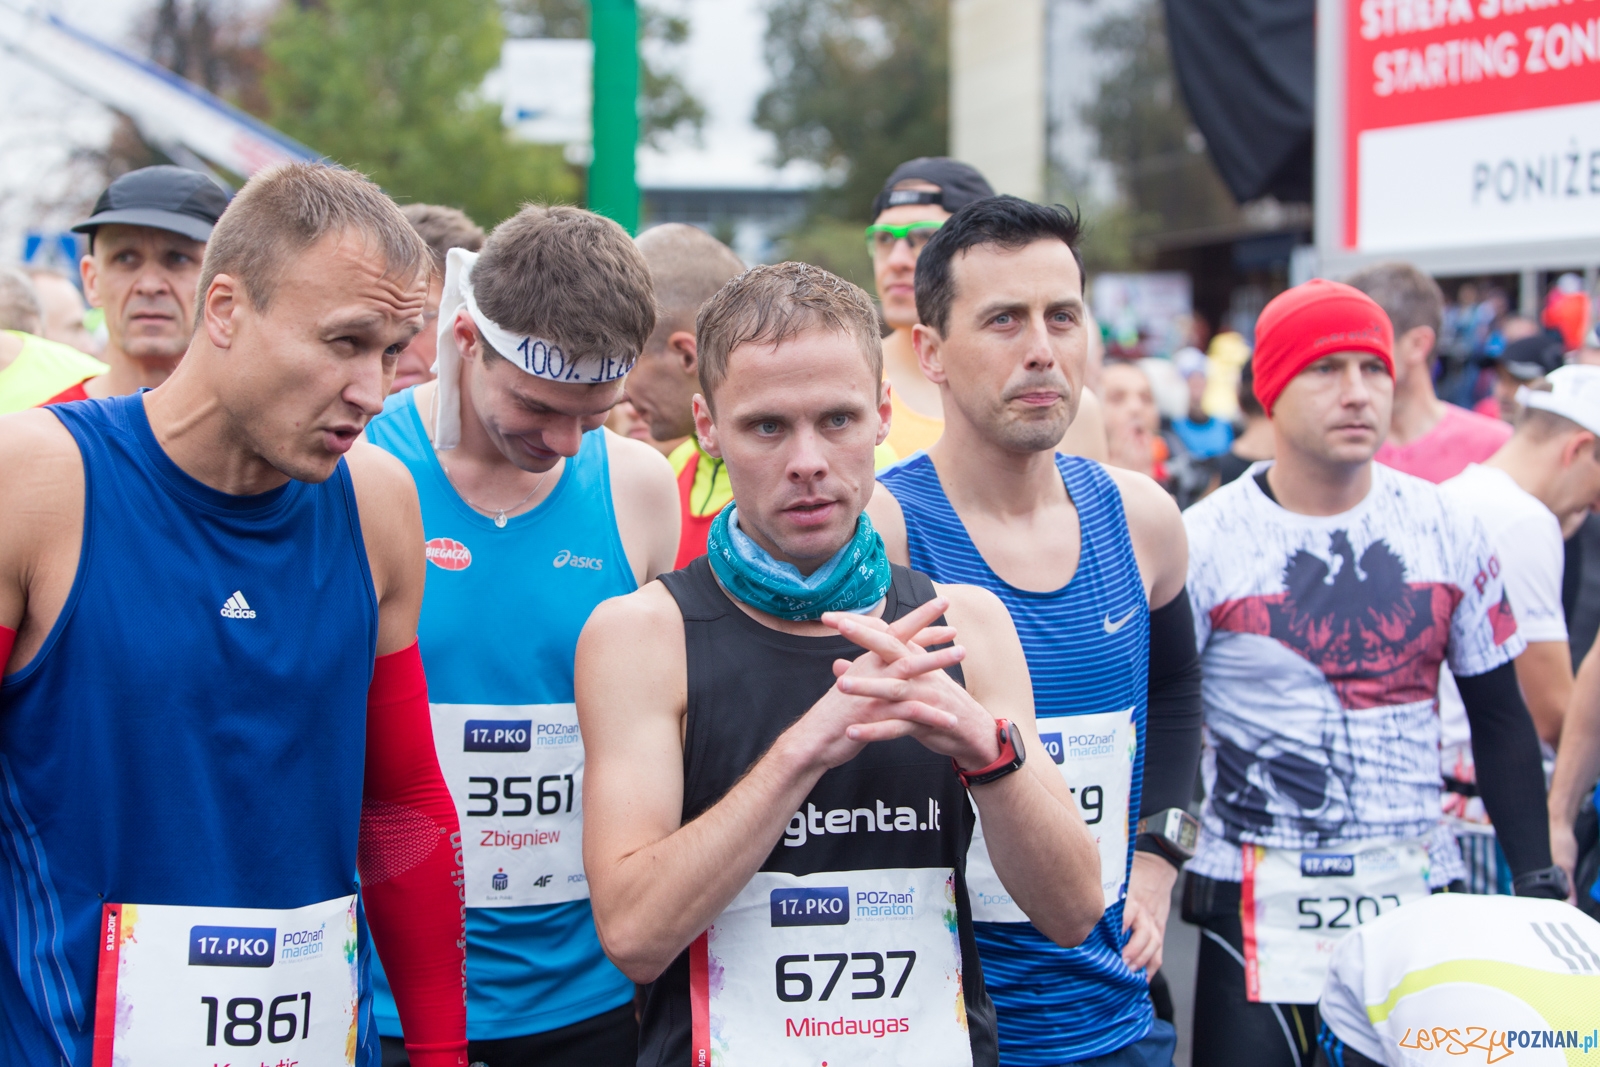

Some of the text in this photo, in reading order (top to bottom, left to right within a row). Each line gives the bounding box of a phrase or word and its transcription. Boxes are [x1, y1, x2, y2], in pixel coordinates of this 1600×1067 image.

[1372, 17, 1600, 97] STARTING ZON
[569, 556, 603, 570] asics
[879, 585, 888, 597] 21
[220, 608, 257, 619] adidas
[494, 729, 527, 744] PKO
[537, 734, 579, 745] maraton
[1069, 744, 1114, 757] maraton
[466, 773, 574, 817] 3561
[480, 829, 561, 850] Zbigniew
[1323, 858, 1353, 873] PKO
[533, 874, 554, 888] 4F
[806, 897, 843, 915] PKO
[857, 902, 914, 917] maraton
[226, 937, 269, 956] PKO
[282, 941, 323, 960] maraton
[775, 950, 917, 1003] 6737
[200, 991, 312, 1047] 1861
[785, 1017, 910, 1038] Mindaugas
